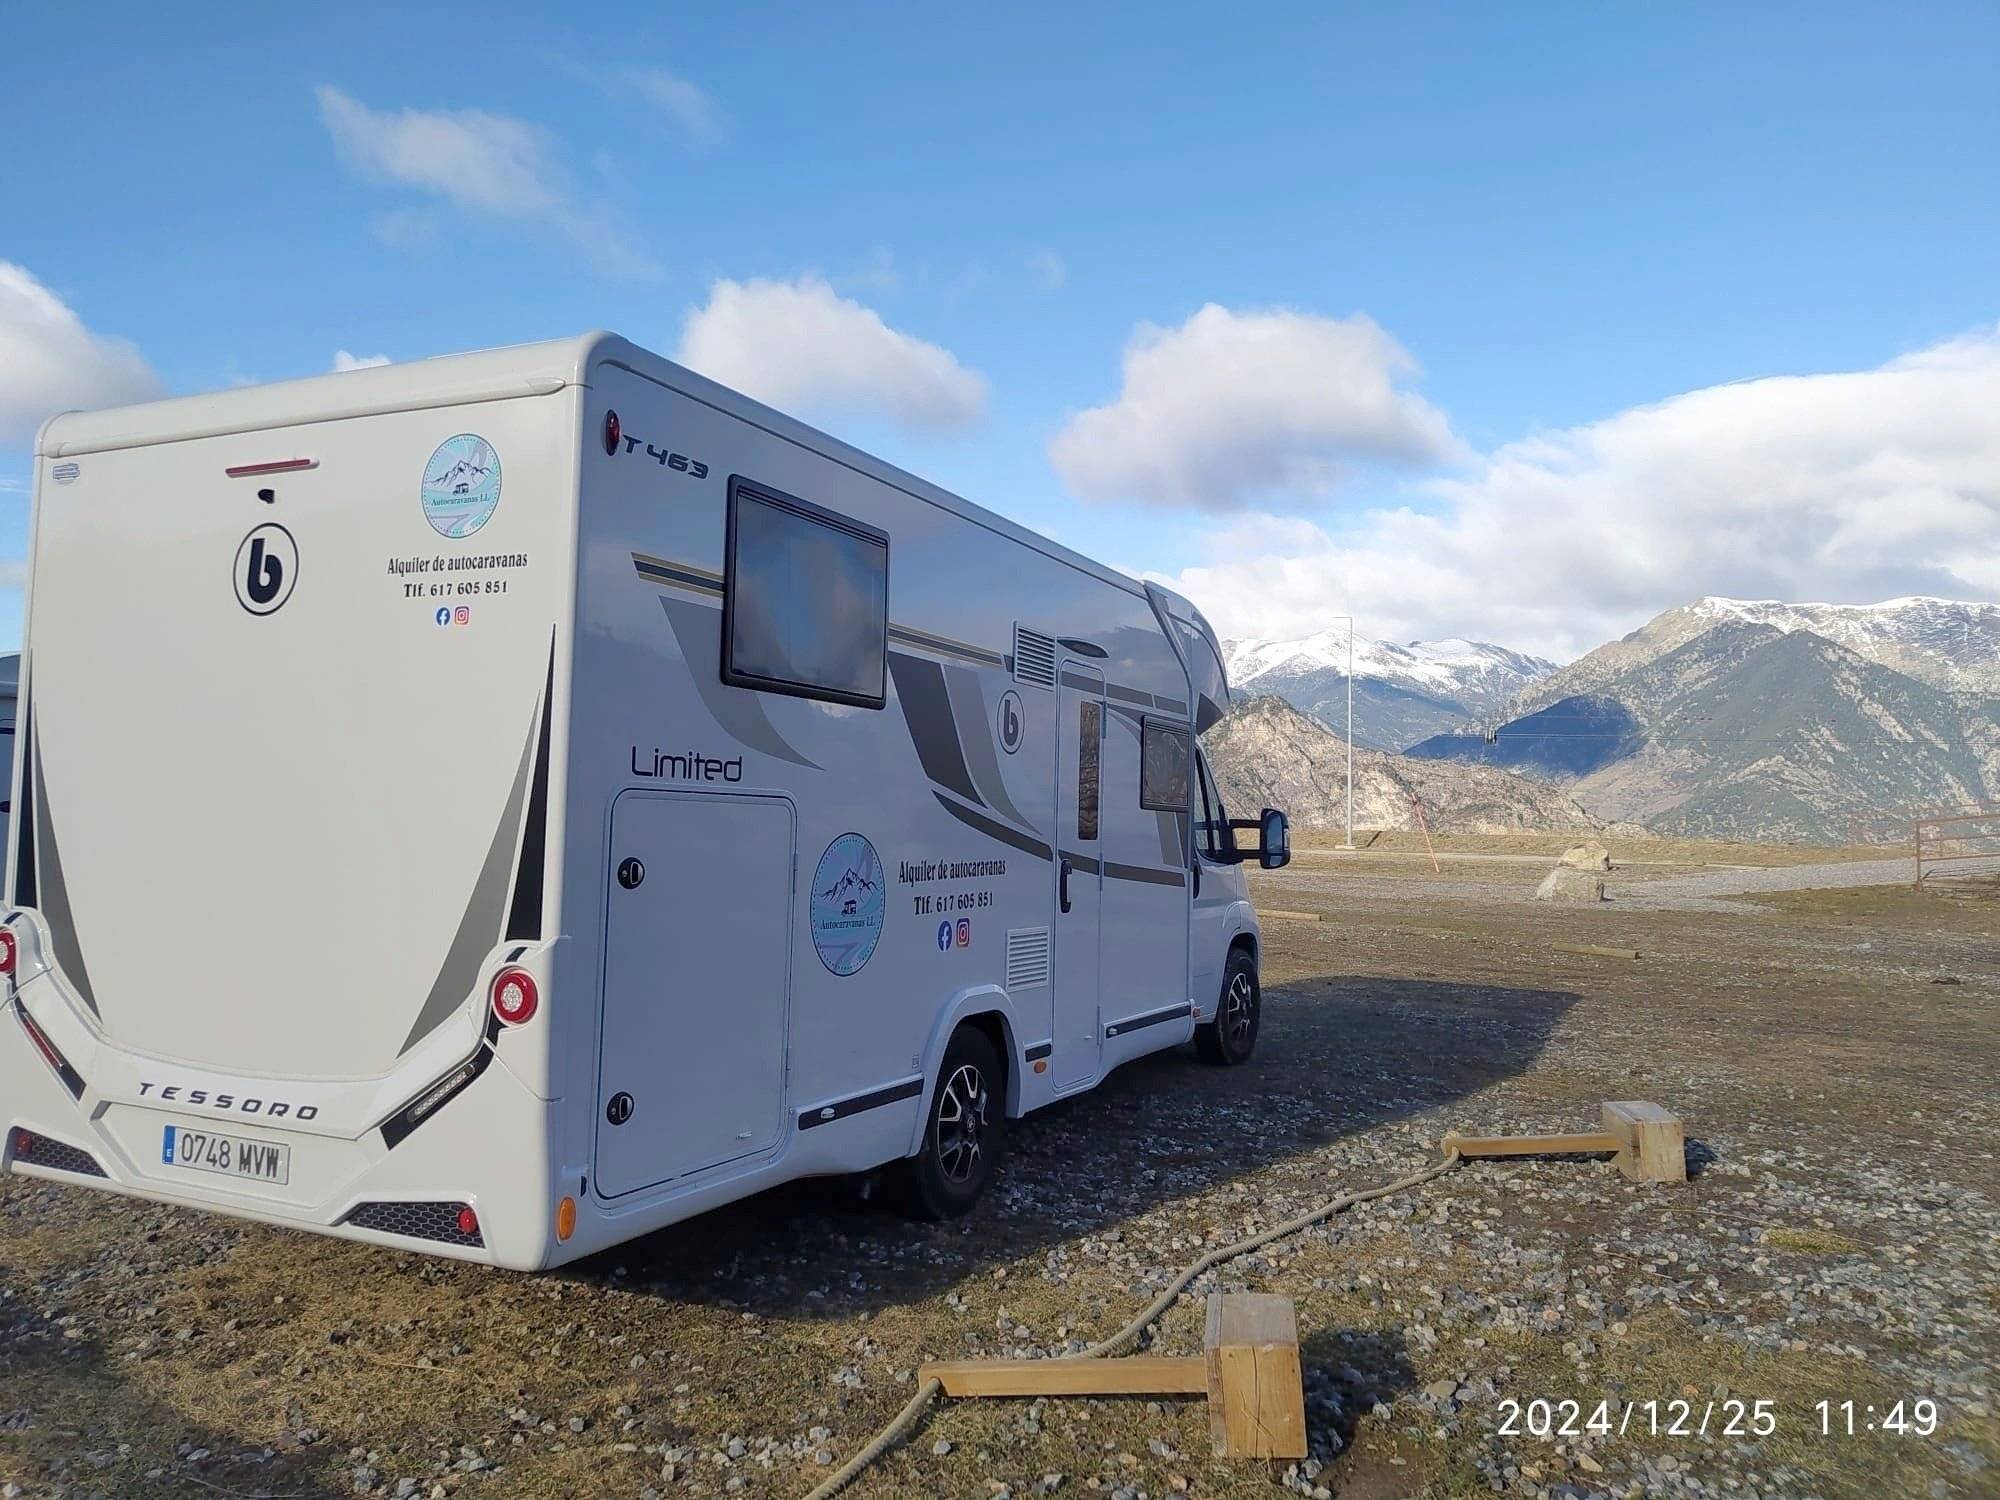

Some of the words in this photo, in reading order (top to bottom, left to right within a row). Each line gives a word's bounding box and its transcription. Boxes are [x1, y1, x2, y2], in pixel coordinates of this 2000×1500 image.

[623, 434, 643, 454] T
[646, 443, 709, 480] 463
[431, 495, 479, 507] Autocaravanas
[387, 556, 430, 578] Alquiler
[432, 555, 445, 572] de
[447, 552, 528, 571] autocaravanas
[430, 583, 452, 597] 617
[457, 581, 480, 595] 605
[485, 580, 508, 594] 851
[632, 745, 743, 782] Limited
[898, 859, 936, 888] Alquiler
[937, 859, 949, 880] de
[950, 859, 1006, 879] autocaravanas
[936, 897, 955, 913] 617
[957, 896, 975, 911] 605
[977, 892, 993, 908] 851
[820, 918, 865, 930] Autocaravanas
[139, 1082, 319, 1121] TESSORO
[181, 1133, 231, 1169] 0748
[238, 1142, 280, 1178] MVW
